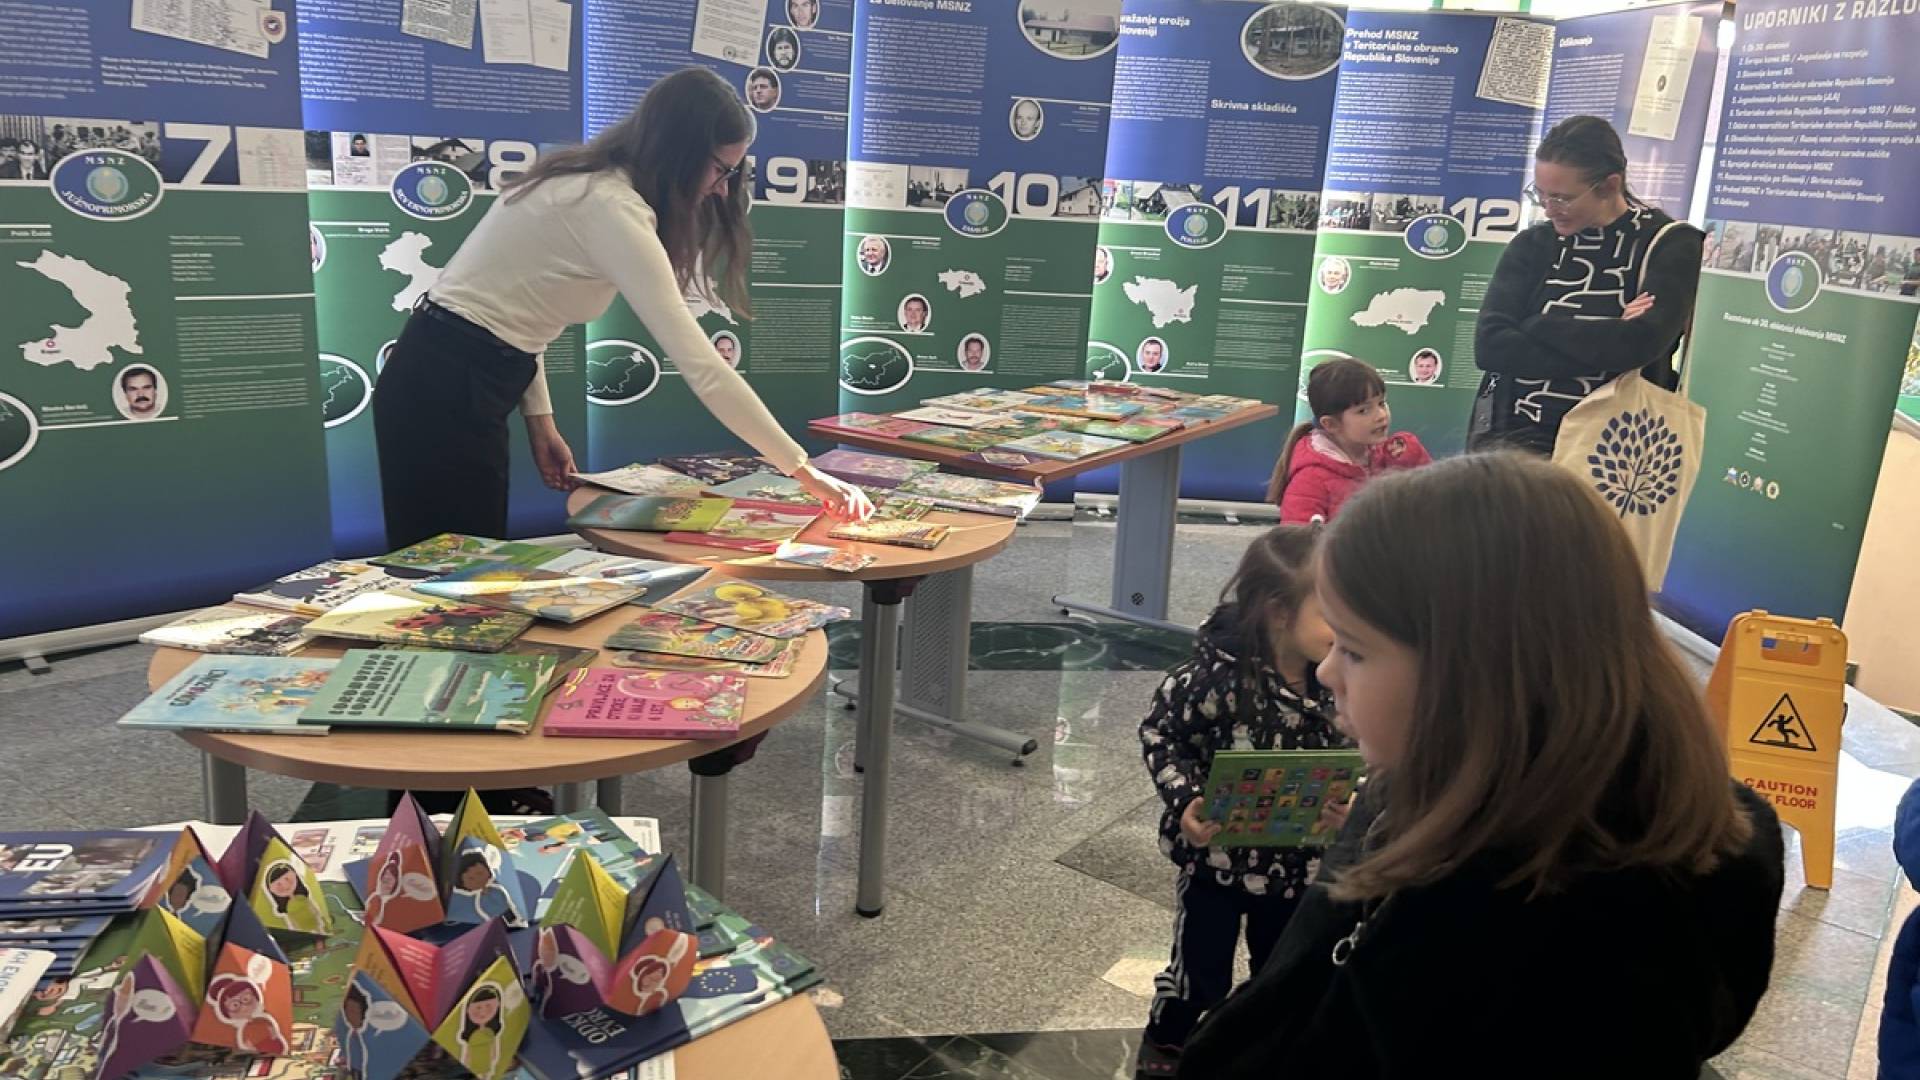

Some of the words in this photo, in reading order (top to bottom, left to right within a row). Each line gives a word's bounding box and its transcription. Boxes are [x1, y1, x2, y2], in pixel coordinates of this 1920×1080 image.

[936, 0, 972, 12] MSNZ
[1743, 5, 1829, 30] UPORNIKI
[1833, 2, 1847, 21] Z
[1850, 0, 1920, 19] RAZLO
[1159, 16, 1191, 27] orožja
[1346, 28, 1382, 41] Prehod
[1384, 30, 1419, 41] MSNZ
[1343, 51, 1392, 64] Republike
[1395, 54, 1440, 66] Slovenije
[1353, 40, 1411, 53] Teritorialno
[1414, 43, 1459, 55] obrambo
[1210, 99, 1249, 111] Skrivna
[1251, 101, 1297, 114] skladišča
[164, 122, 231, 185] 7
[488, 140, 537, 190] 8
[765, 156, 808, 202] 9
[988, 171, 1059, 217] 10
[1213, 186, 1272, 229] 11
[1449, 197, 1521, 238] 12
[1744, 777, 1817, 796] CAUTION
[1776, 795, 1816, 809] FLOOR
[12, 843, 73, 872] EU
